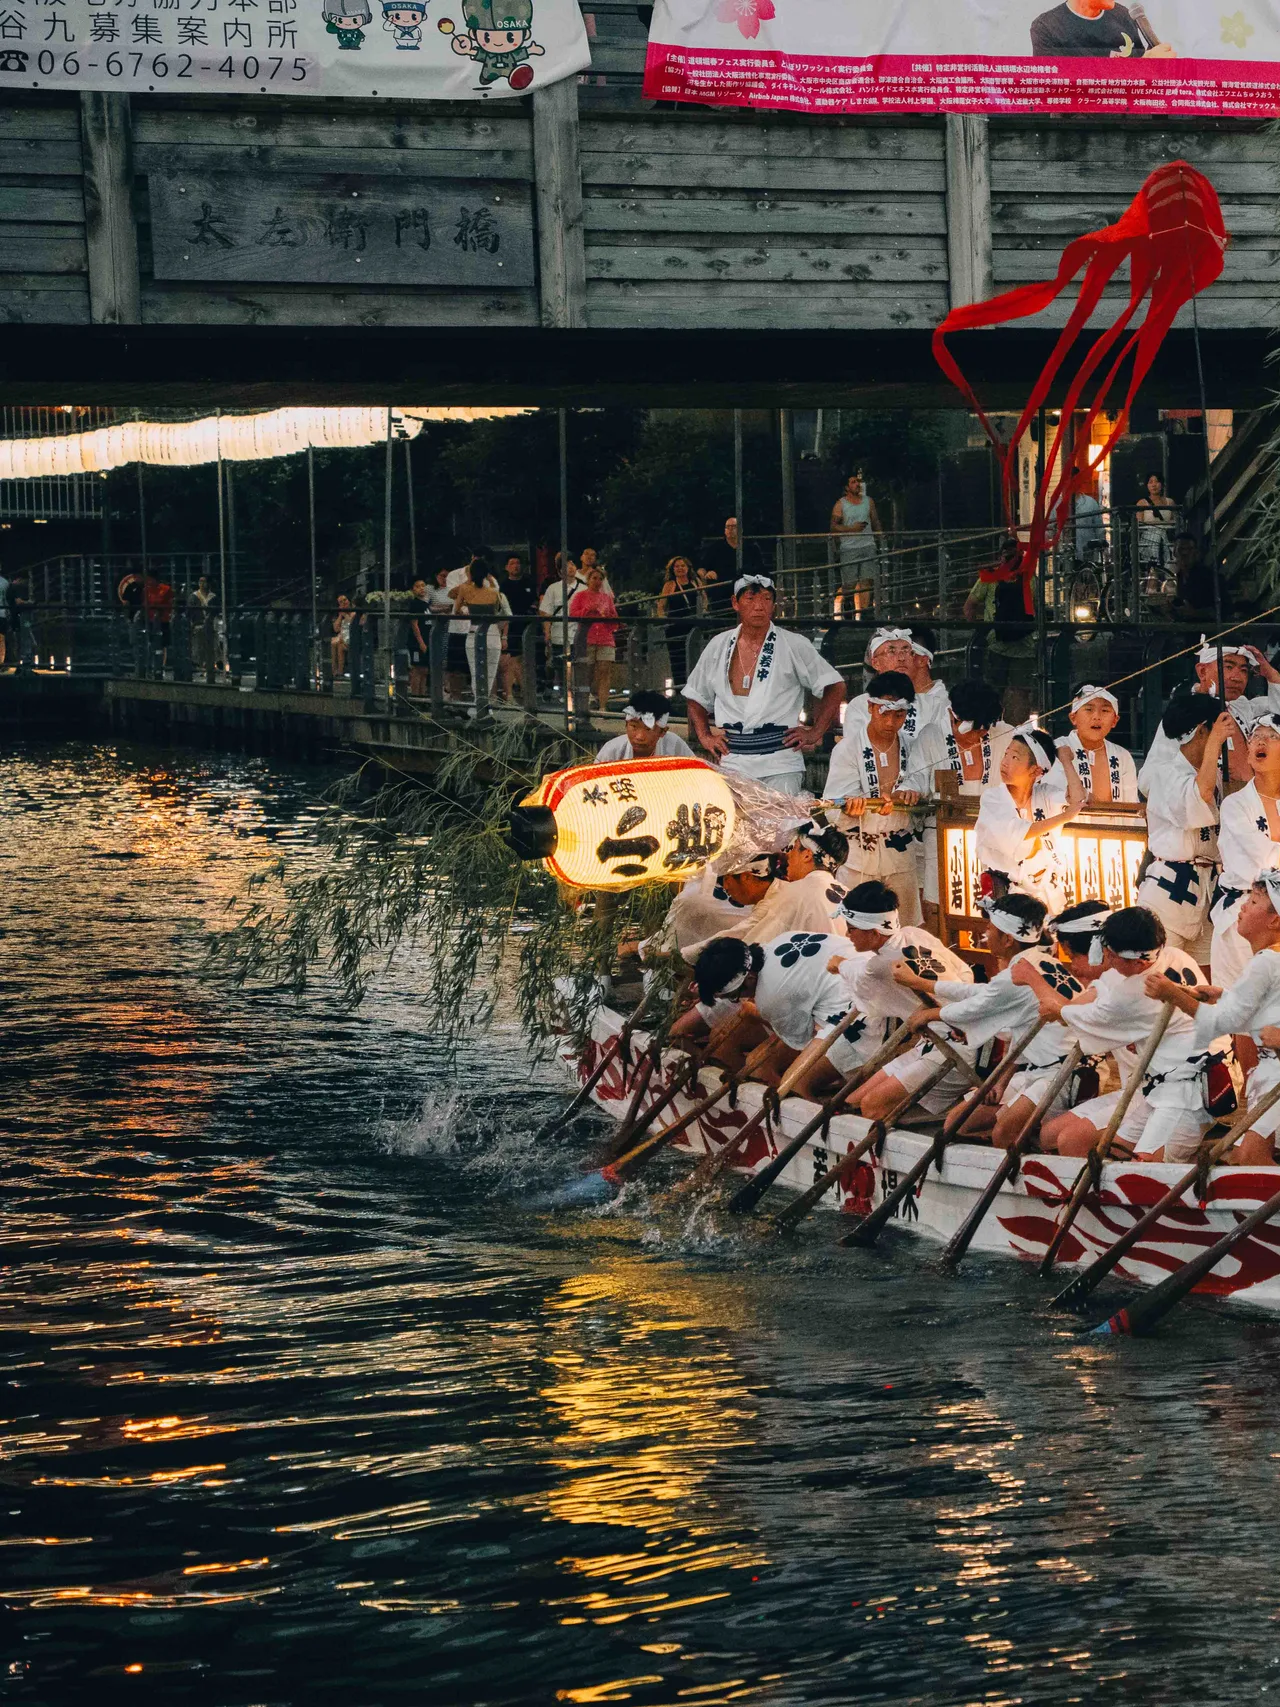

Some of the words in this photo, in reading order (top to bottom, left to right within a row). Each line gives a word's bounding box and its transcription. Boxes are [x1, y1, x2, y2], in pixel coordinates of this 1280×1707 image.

[391, 3, 418, 11] OSAKA
[496, 19, 530, 29] OSAKA
[37, 49, 307, 81] 06-6762-4075
[748, 92, 770, 100] Airbnb
[770, 94, 789, 102] Japan
